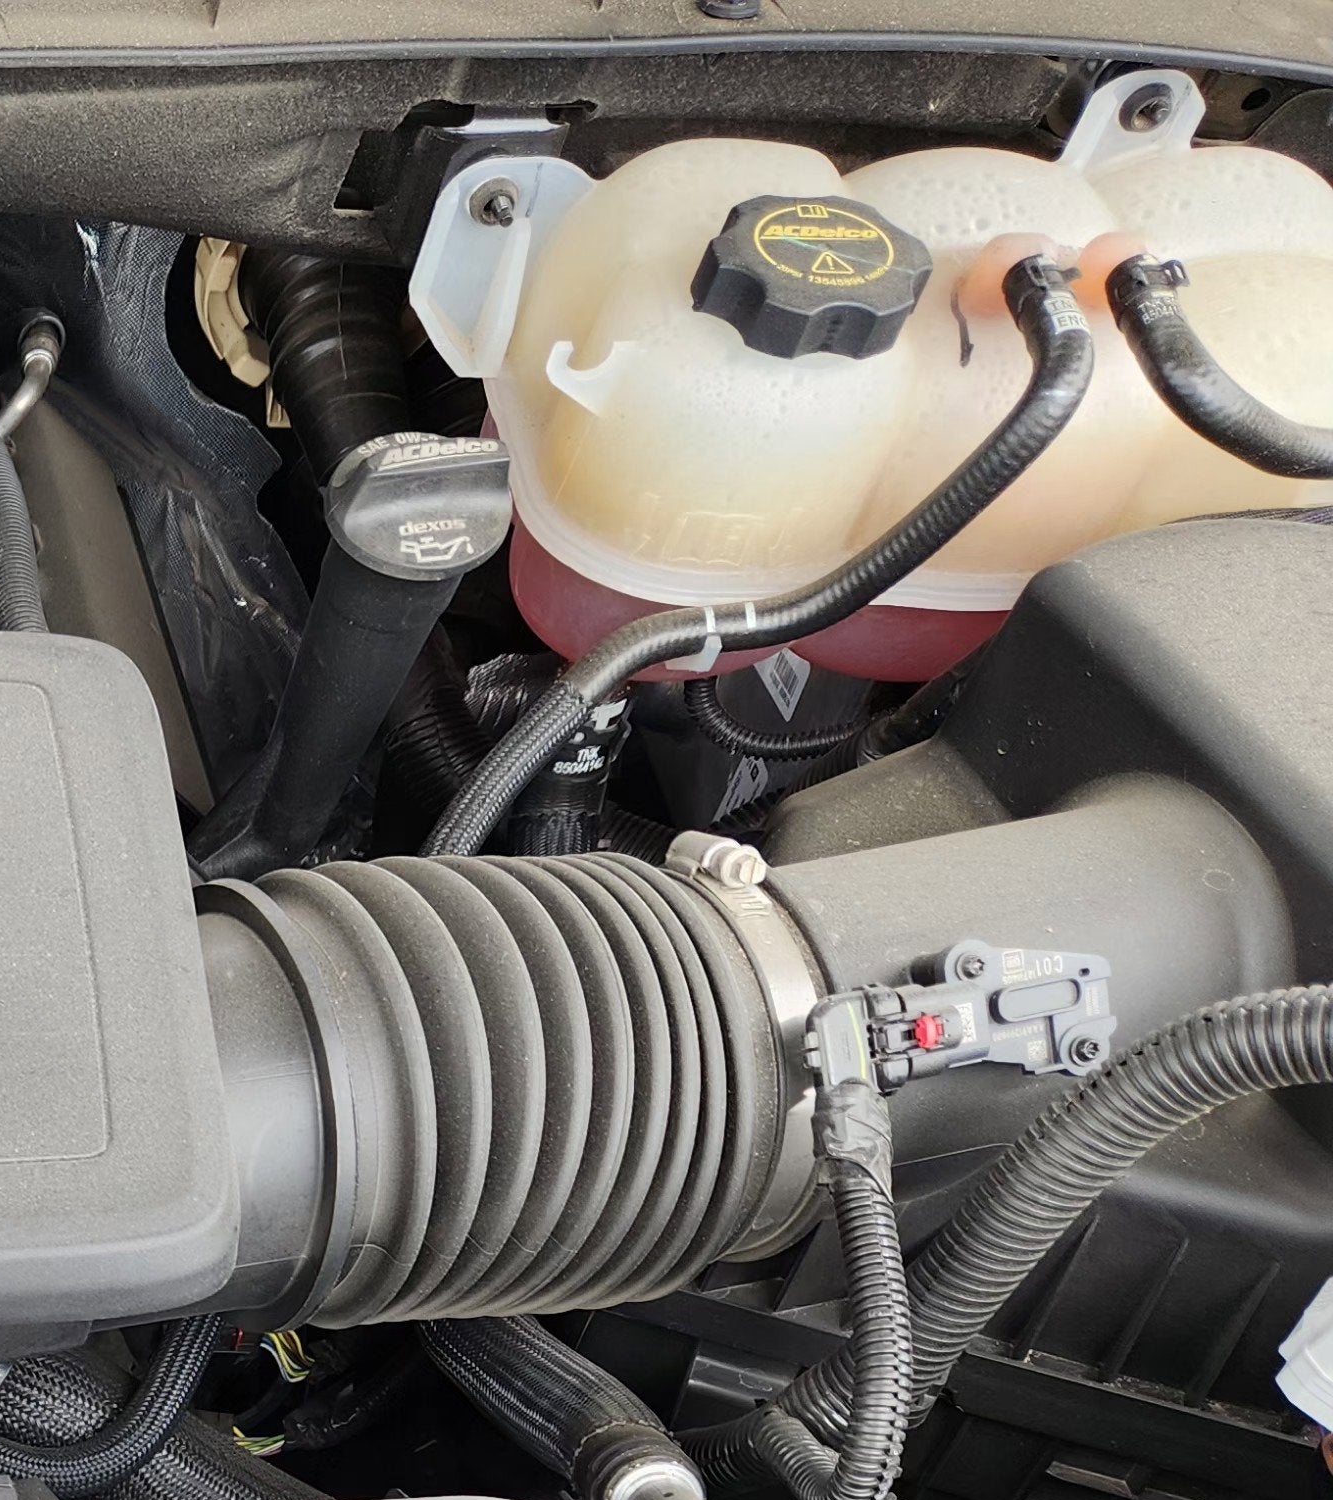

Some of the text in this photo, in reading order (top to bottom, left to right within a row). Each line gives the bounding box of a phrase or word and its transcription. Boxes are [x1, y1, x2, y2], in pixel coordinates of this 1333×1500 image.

[762, 225, 878, 238] ACDelco
[358, 435, 390, 457] SAE
[382, 438, 499, 465] ACDelco
[399, 518, 467, 537] dexos
[1035, 955, 1064, 976] C01
